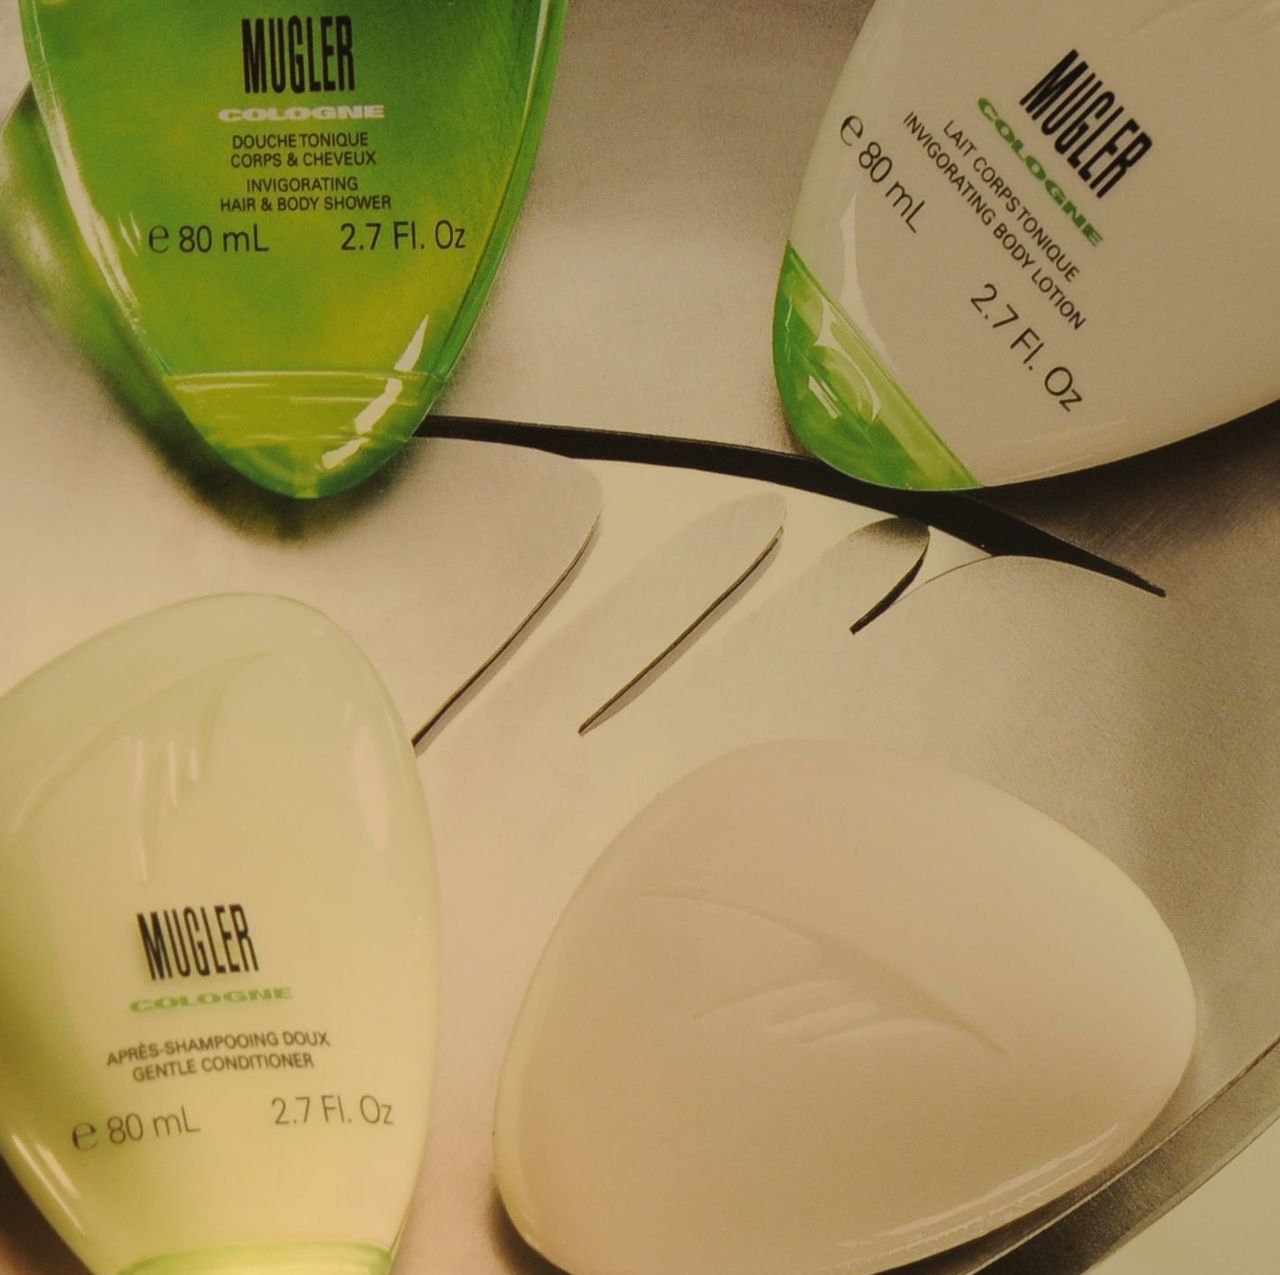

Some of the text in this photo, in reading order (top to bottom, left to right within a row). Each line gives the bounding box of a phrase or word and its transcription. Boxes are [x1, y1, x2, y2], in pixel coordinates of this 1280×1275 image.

[242, 15, 356, 94] MUGLER
[218, 104, 385, 122] COLOGNE
[1019, 48, 1153, 199] MUGLER
[232, 131, 369, 150] DOUCHE TONIQUE
[230, 150, 377, 169] CORPS & CHEVEUX
[977, 96, 1104, 248] COLOGNE
[246, 176, 359, 193] INVIGORATING
[858, 141, 894, 184] 80
[884, 180, 931, 234] mL
[220, 194, 392, 213] HAIR & BODY SHOWER
[943, 119, 1080, 284] LAIT CORPS TONIQUE
[340, 221, 382, 251] 2.7
[434, 219, 466, 249] Oz
[903, 111, 1086, 330] INVIGORATING BODY LOTION
[178, 224, 212, 253] 80
[222, 223, 269, 252] mL
[970, 282, 1019, 330] 2.7
[1043, 364, 1083, 413] Oz
[136, 903, 259, 981] MUGLER
[129, 986, 294, 1012] COLOGNE
[106, 1031, 331, 1066] APRÈS-SHAMPOOING DOUX
[132, 1052, 314, 1083] GENTLE CONDITIONER
[108, 1113, 144, 1145] 80
[153, 1106, 201, 1138] mL
[271, 1096, 312, 1126] 2.7
[359, 1094, 394, 1125] Oz
